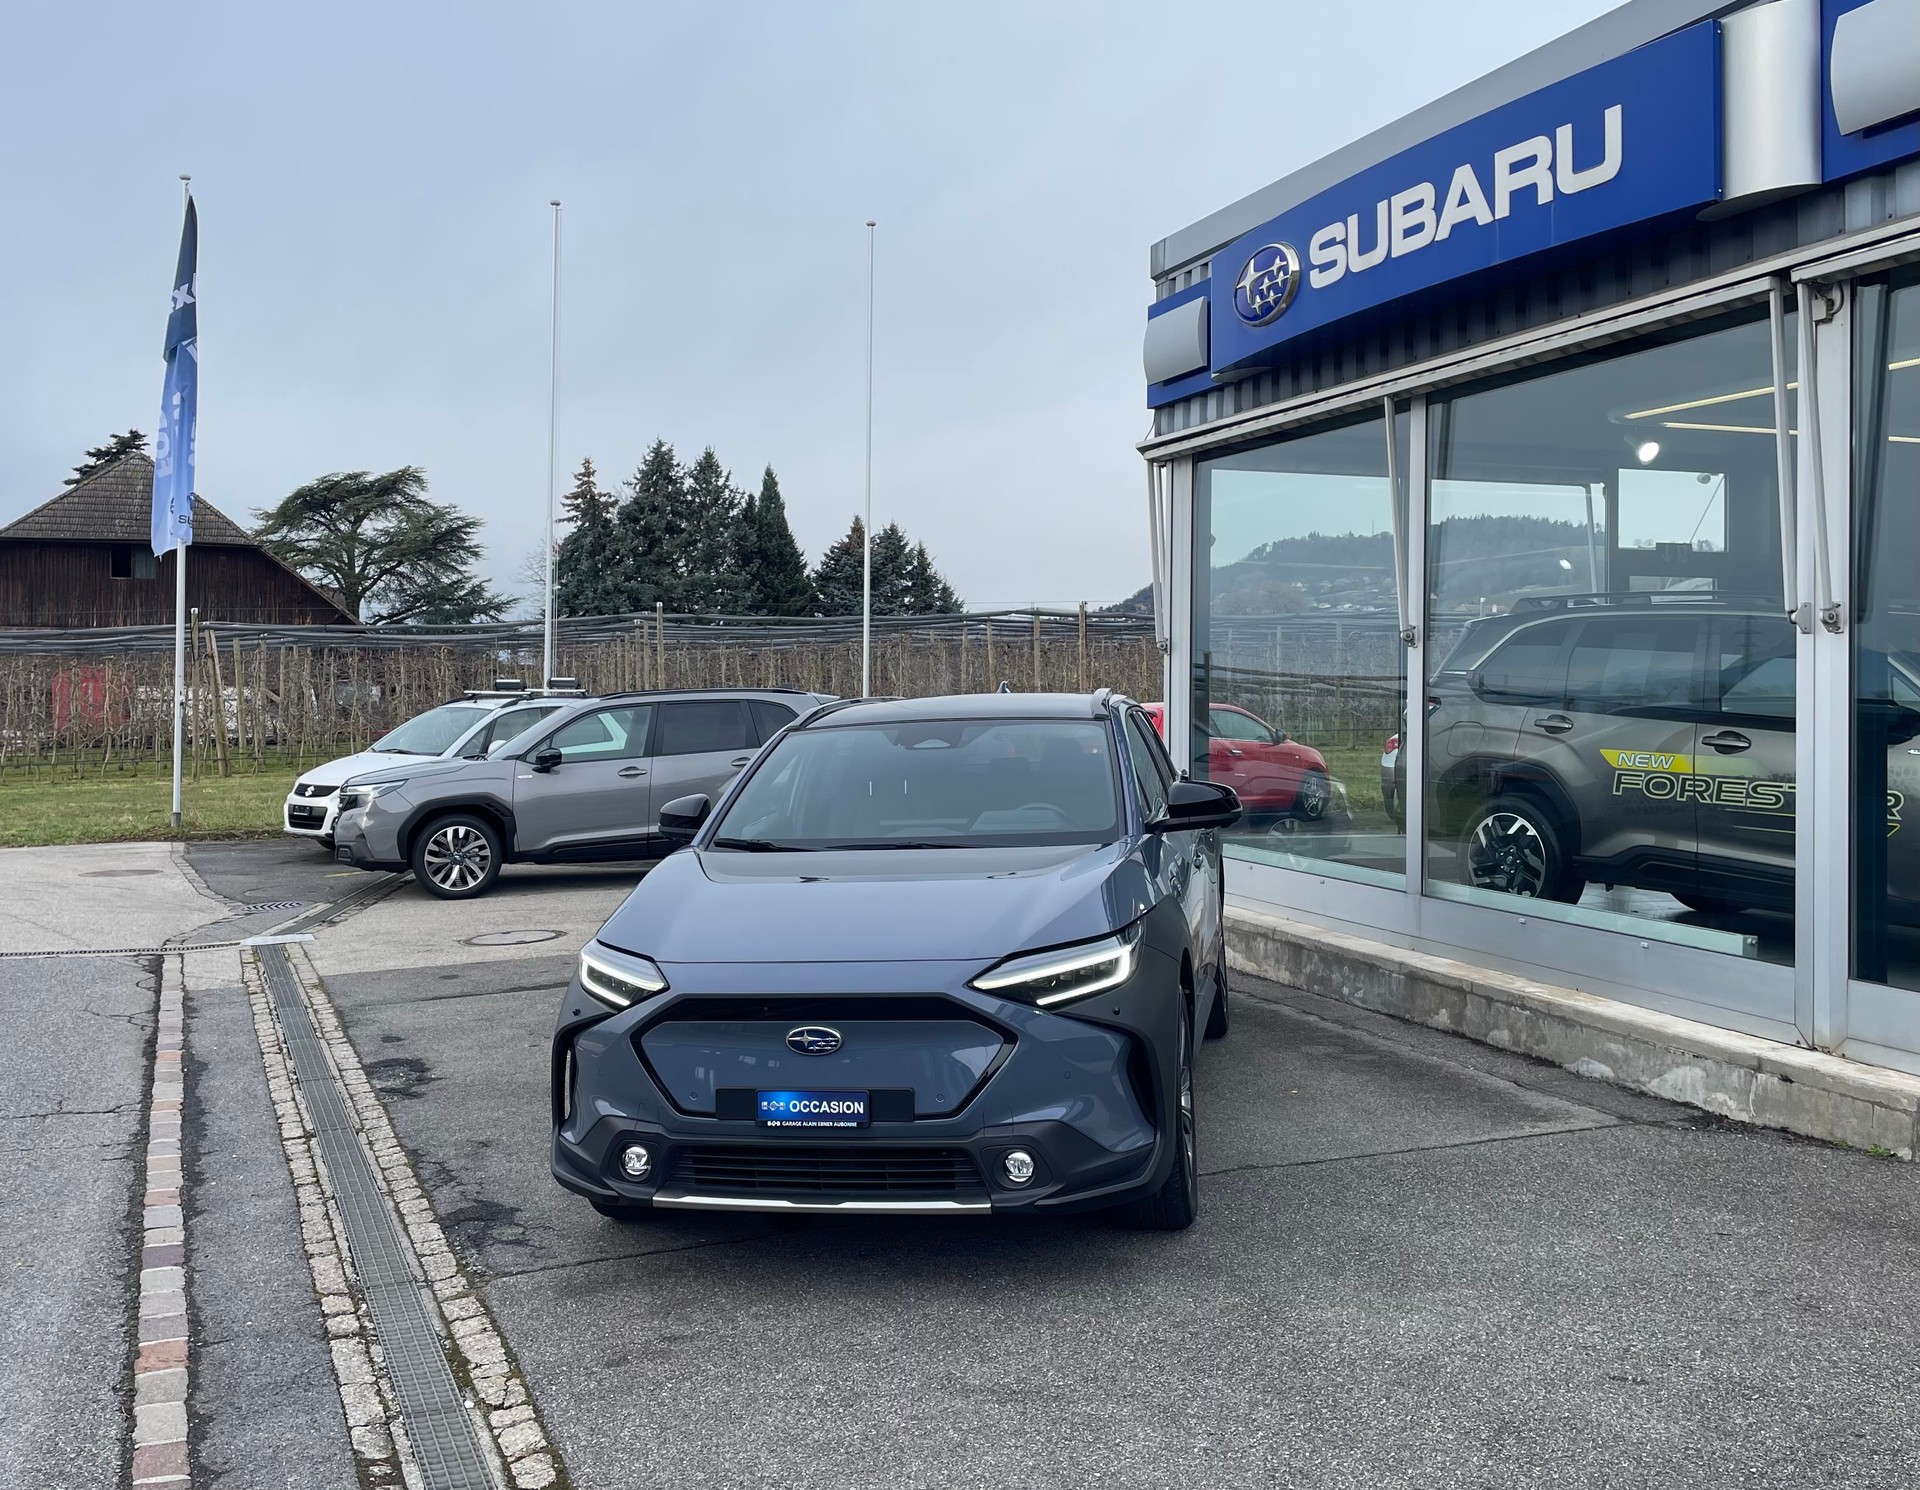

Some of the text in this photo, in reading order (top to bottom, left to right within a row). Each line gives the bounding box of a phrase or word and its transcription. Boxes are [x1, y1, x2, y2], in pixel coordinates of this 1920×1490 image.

[1309, 104, 1622, 289] SUBARU
[1617, 752, 1674, 769] NEW
[789, 1100, 864, 1114] OCCASION
